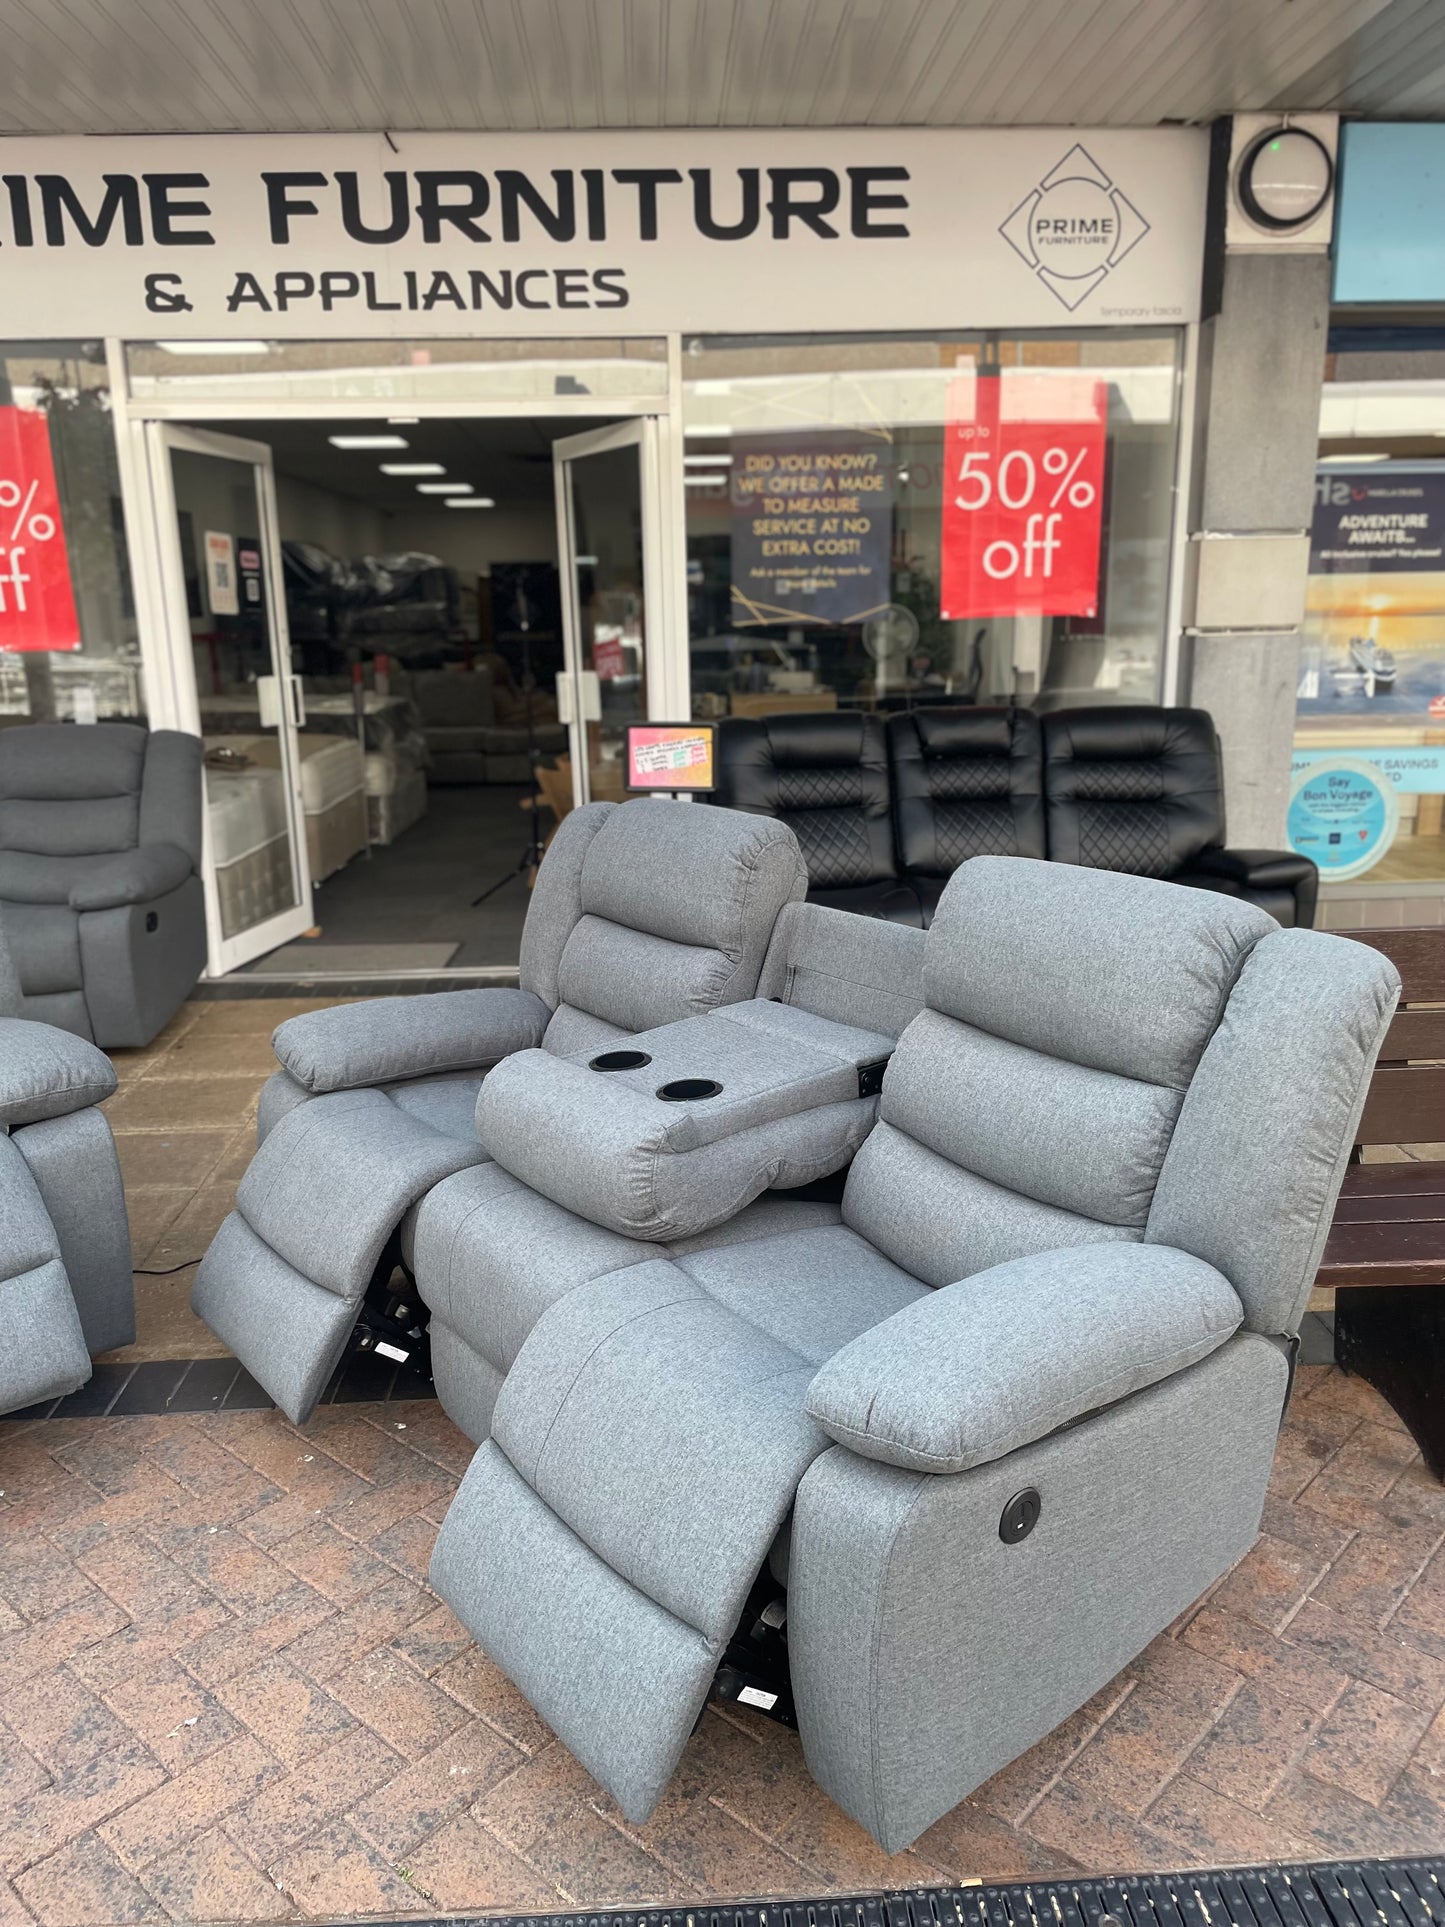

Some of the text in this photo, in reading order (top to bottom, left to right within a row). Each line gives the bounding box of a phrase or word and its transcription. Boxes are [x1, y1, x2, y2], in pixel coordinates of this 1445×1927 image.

[0, 166, 911, 247] IME FURNITURE
[1036, 218, 1113, 234] PRIME
[1038, 236, 1108, 246] FURNITURE
[145, 269, 629, 312] & APPLIANCES
[958, 426, 990, 441] up to
[745, 453, 878, 472] DID YOU KNOW?
[738, 476, 764, 493] WE
[768, 475, 819, 492] OFFER
[822, 475, 835, 491] A
[838, 475, 884, 491] MADE
[954, 447, 1095, 511] 50%
[763, 496, 860, 514] TO MEASURE
[752, 517, 871, 535] SERVICE AT NO
[1339, 514, 1428, 528] ADVENTURE
[761, 539, 861, 556] EXTRA COST!
[982, 513, 1062, 580] off
[1385, 758, 1439, 770] SAVINGS
[1328, 777, 1351, 789] Say
[1303, 788, 1374, 802] Bon Voyage
